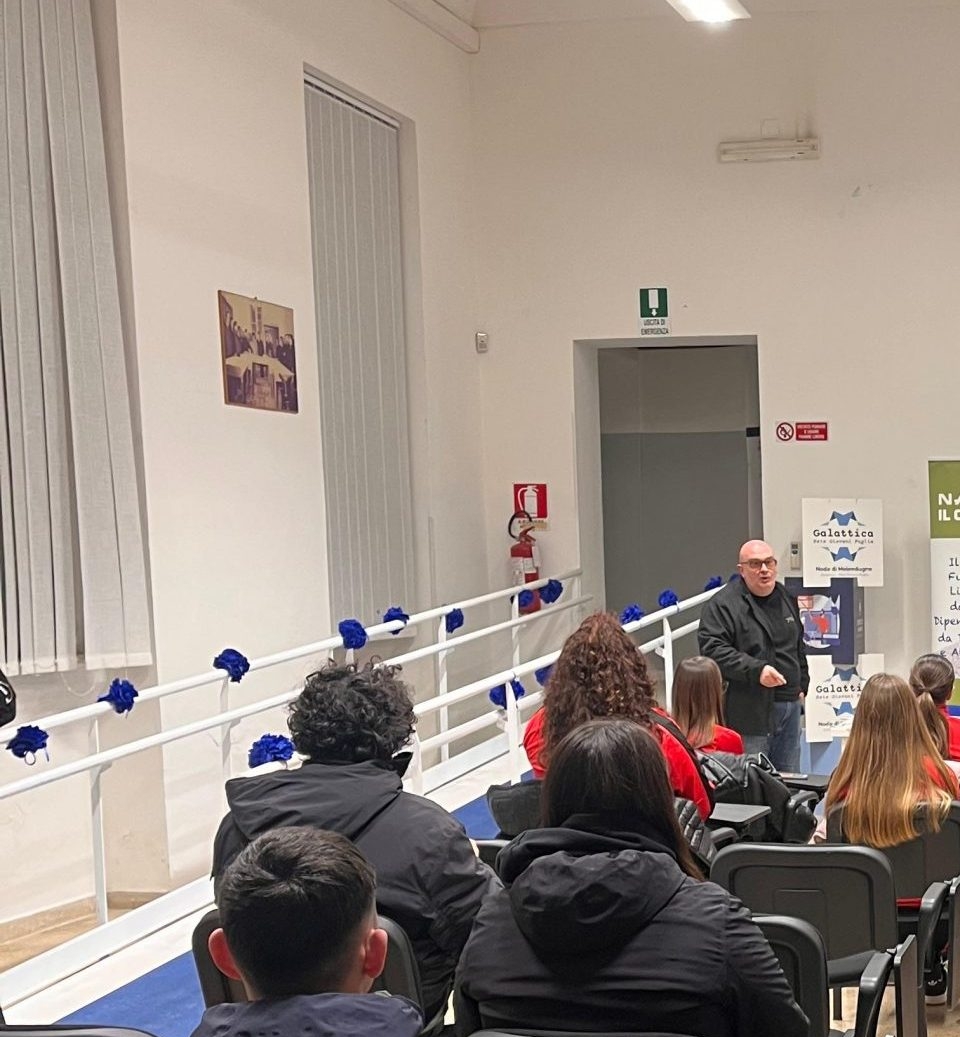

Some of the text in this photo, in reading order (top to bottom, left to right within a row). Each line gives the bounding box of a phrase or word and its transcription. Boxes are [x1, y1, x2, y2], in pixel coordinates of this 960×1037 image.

[938, 509, 951, 521] IL
[813, 528, 874, 537] Galattica
[949, 557, 959, 567] Il
[937, 632, 952, 643] da
[815, 683, 862, 693] Galatti
